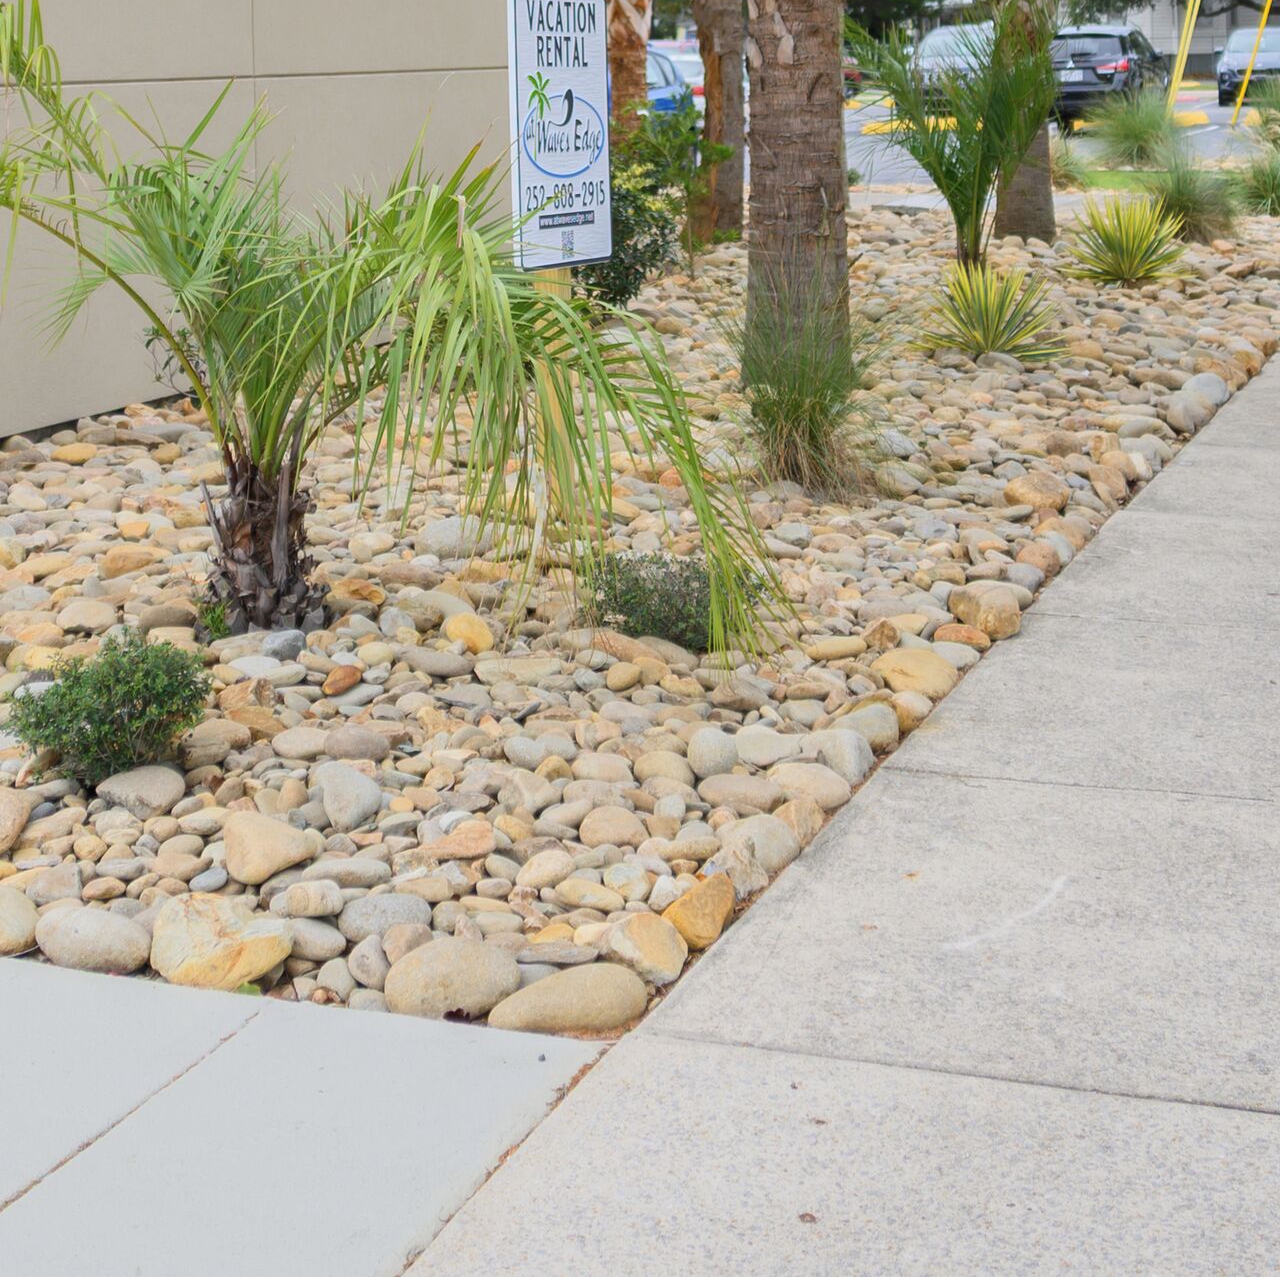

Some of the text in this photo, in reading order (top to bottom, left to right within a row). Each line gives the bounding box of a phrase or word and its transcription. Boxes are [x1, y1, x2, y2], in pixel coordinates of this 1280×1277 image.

[526, 0, 597, 34] VACATION
[536, 35, 589, 68] RENTAL
[537, 120, 571, 154] Waves
[574, 118, 601, 165] Edge
[525, 180, 606, 212] 252-808-2915
